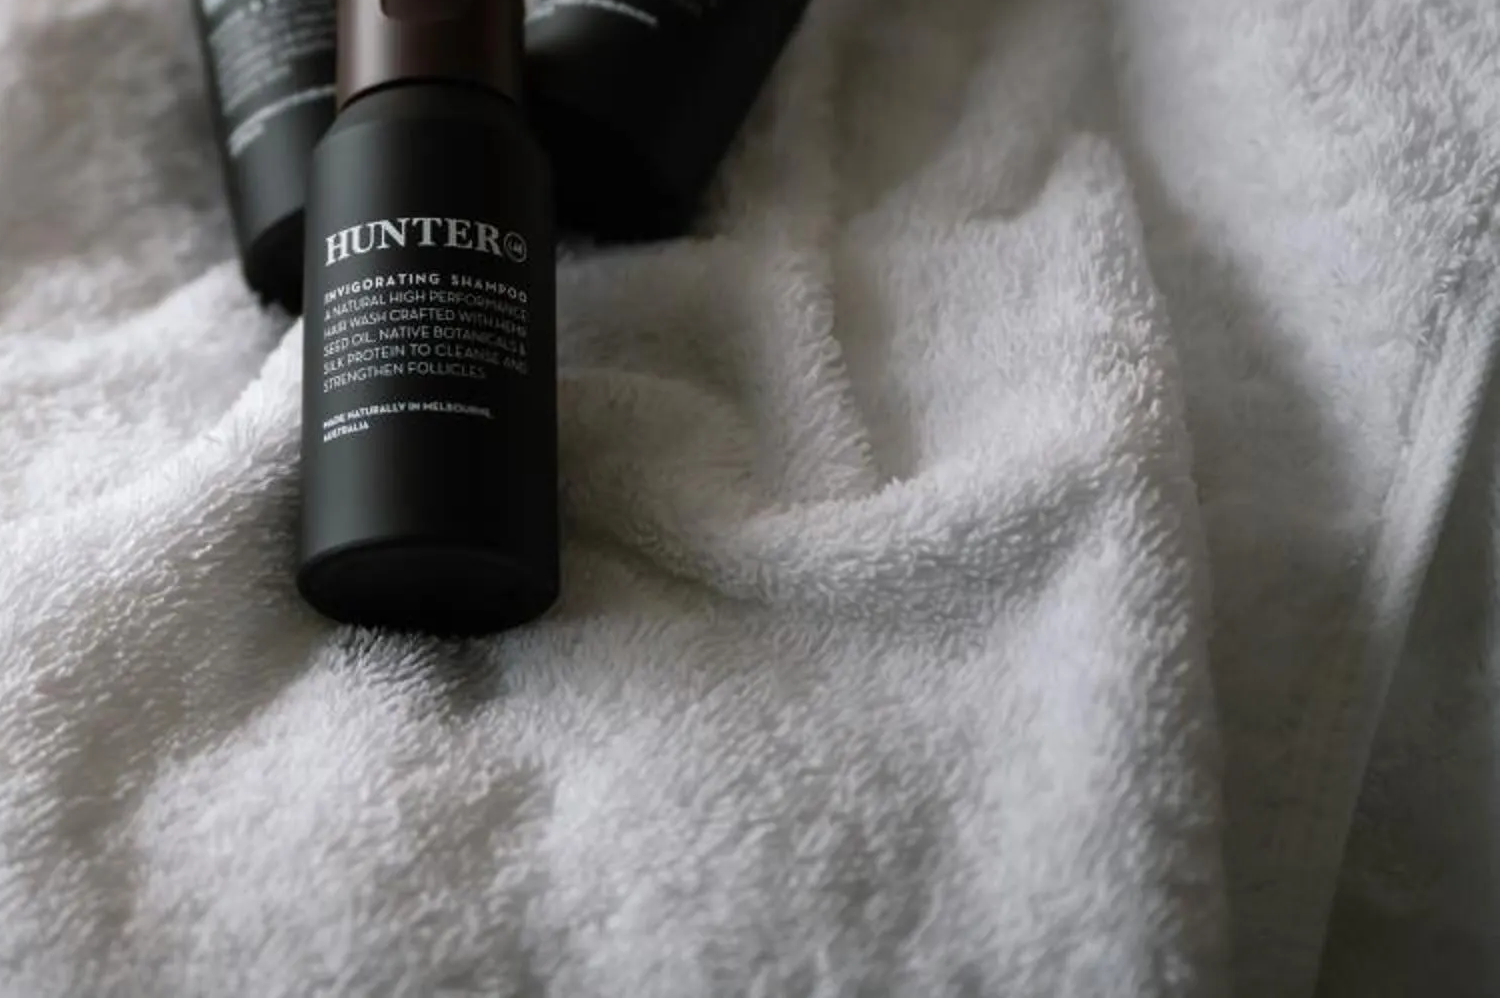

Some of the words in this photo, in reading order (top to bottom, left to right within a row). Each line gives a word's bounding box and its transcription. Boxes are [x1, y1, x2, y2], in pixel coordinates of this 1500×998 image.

[325, 217, 504, 267] HUNTER
[324, 273, 441, 303] INVIGORATING
[451, 273, 528, 303] SHAMPOO
[332, 291, 386, 319] NATURAL
[389, 289, 425, 303] HIGH
[349, 311, 387, 330] WASH
[389, 307, 455, 322] CRAFTED
[379, 325, 430, 342] NATIVE
[347, 343, 405, 365] PROTEIN
[409, 343, 434, 358] TO
[323, 362, 404, 393] STRENGTHEN
[407, 402, 421, 411] IN
